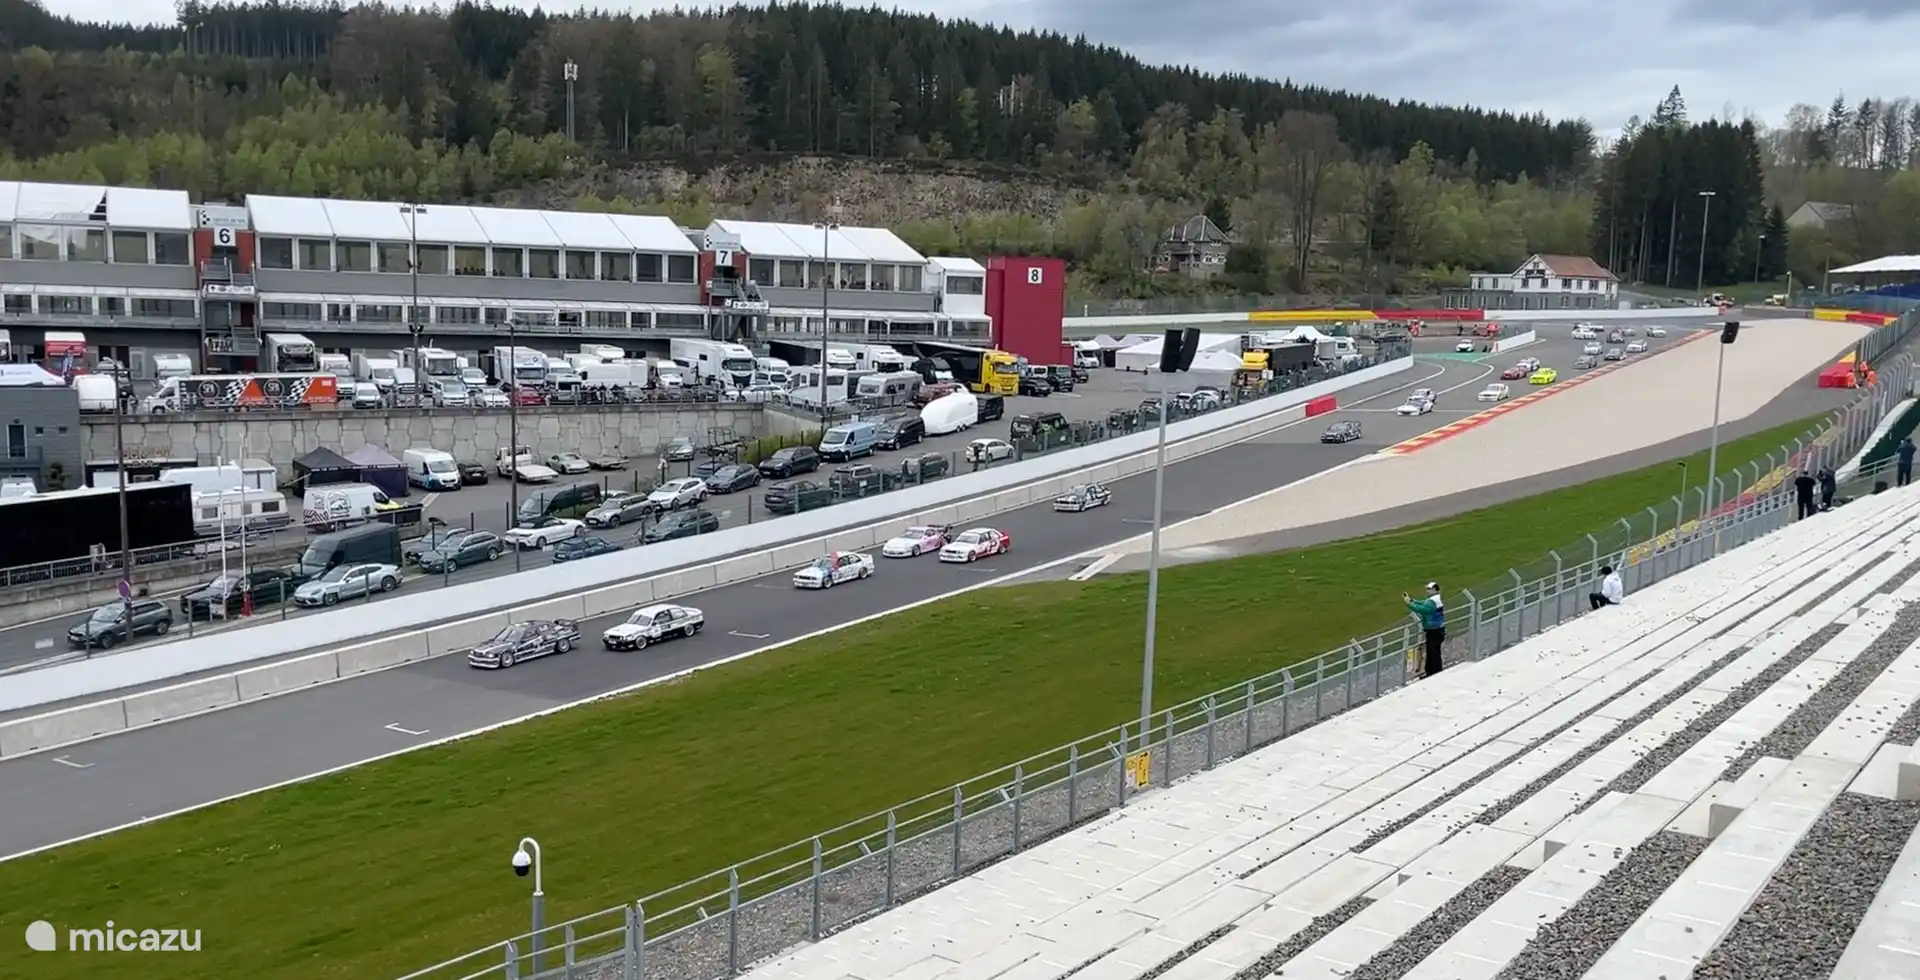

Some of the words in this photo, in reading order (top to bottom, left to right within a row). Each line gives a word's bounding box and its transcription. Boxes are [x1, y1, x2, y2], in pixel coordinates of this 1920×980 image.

[219, 228, 230, 244] 6
[719, 250, 729, 264] 7
[1031, 269, 1039, 282] 8
